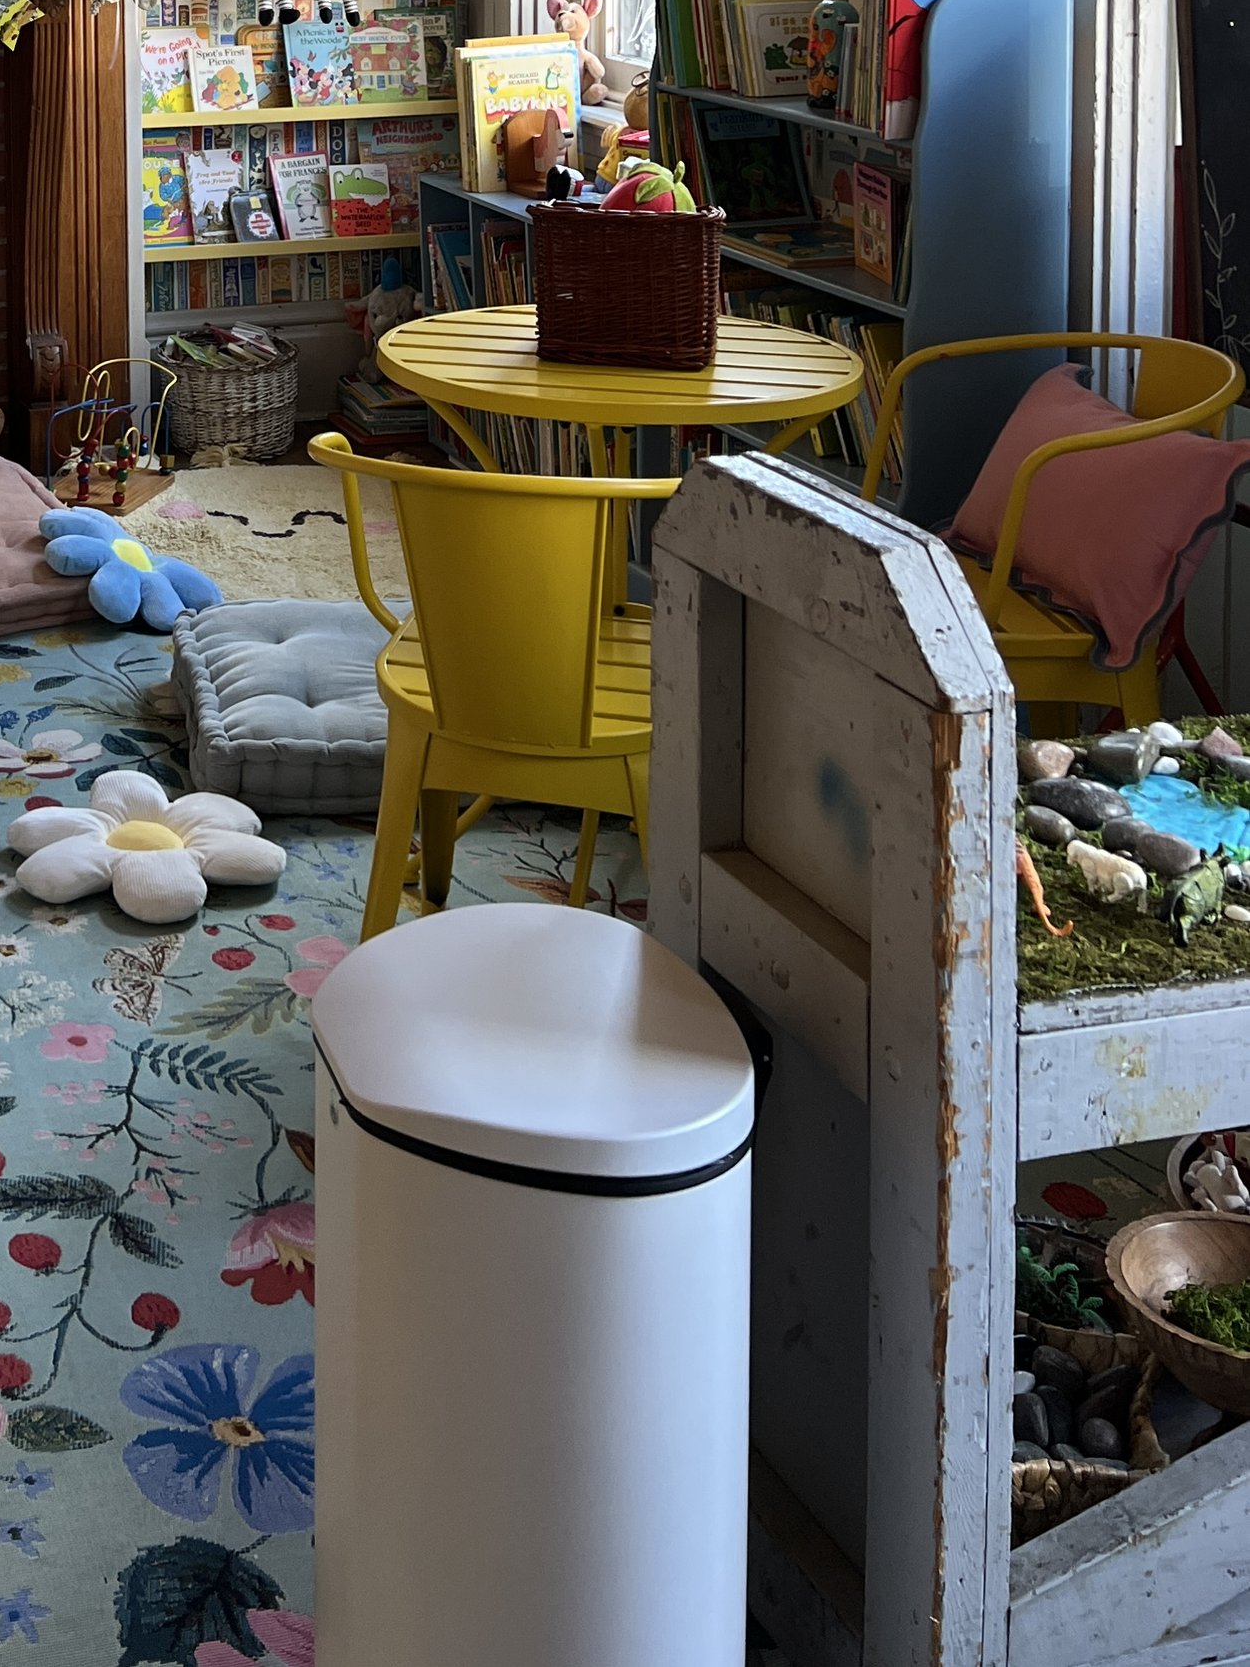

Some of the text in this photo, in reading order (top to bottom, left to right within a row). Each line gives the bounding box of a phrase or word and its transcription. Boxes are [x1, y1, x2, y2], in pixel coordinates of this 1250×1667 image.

[295, 29, 301, 37] A
[303, 29, 325, 37] Picnic
[145, 37, 193, 55] We're Going
[300, 37, 342, 45] the Woods
[196, 48, 246, 59] Spot's First
[158, 56, 175, 65] on a
[208, 57, 236, 67] Picnic
[372, 120, 434, 134] ARTHUR'S
[376, 133, 444, 146] NEIGHBORHOOD
[143, 159, 181, 169] OUSE
[281, 158, 321, 169] A BARGAIN
[279, 168, 328, 178] FOR FRANCES
